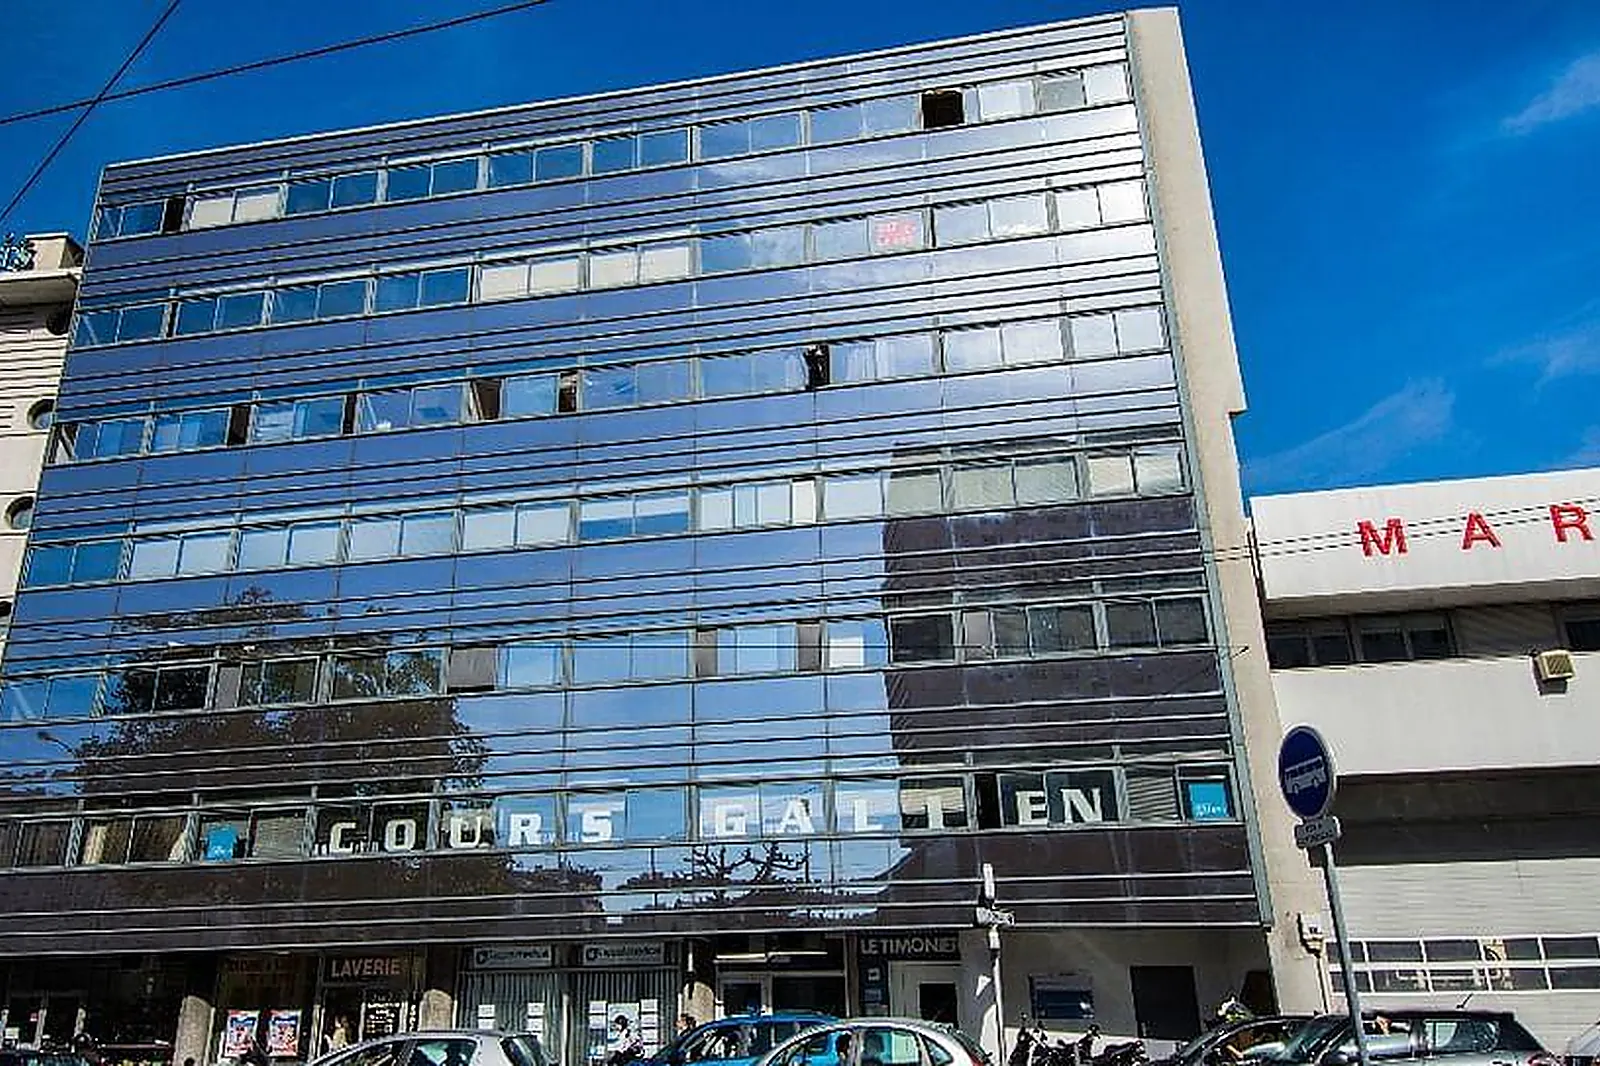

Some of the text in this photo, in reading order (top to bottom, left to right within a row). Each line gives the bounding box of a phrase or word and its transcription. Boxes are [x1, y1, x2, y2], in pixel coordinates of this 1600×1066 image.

[1357, 504, 1594, 557] MAR
[329, 787, 1102, 853] COURS GALIEN
[860, 938, 878, 955] LE
[331, 957, 401, 978] LAVERIE
